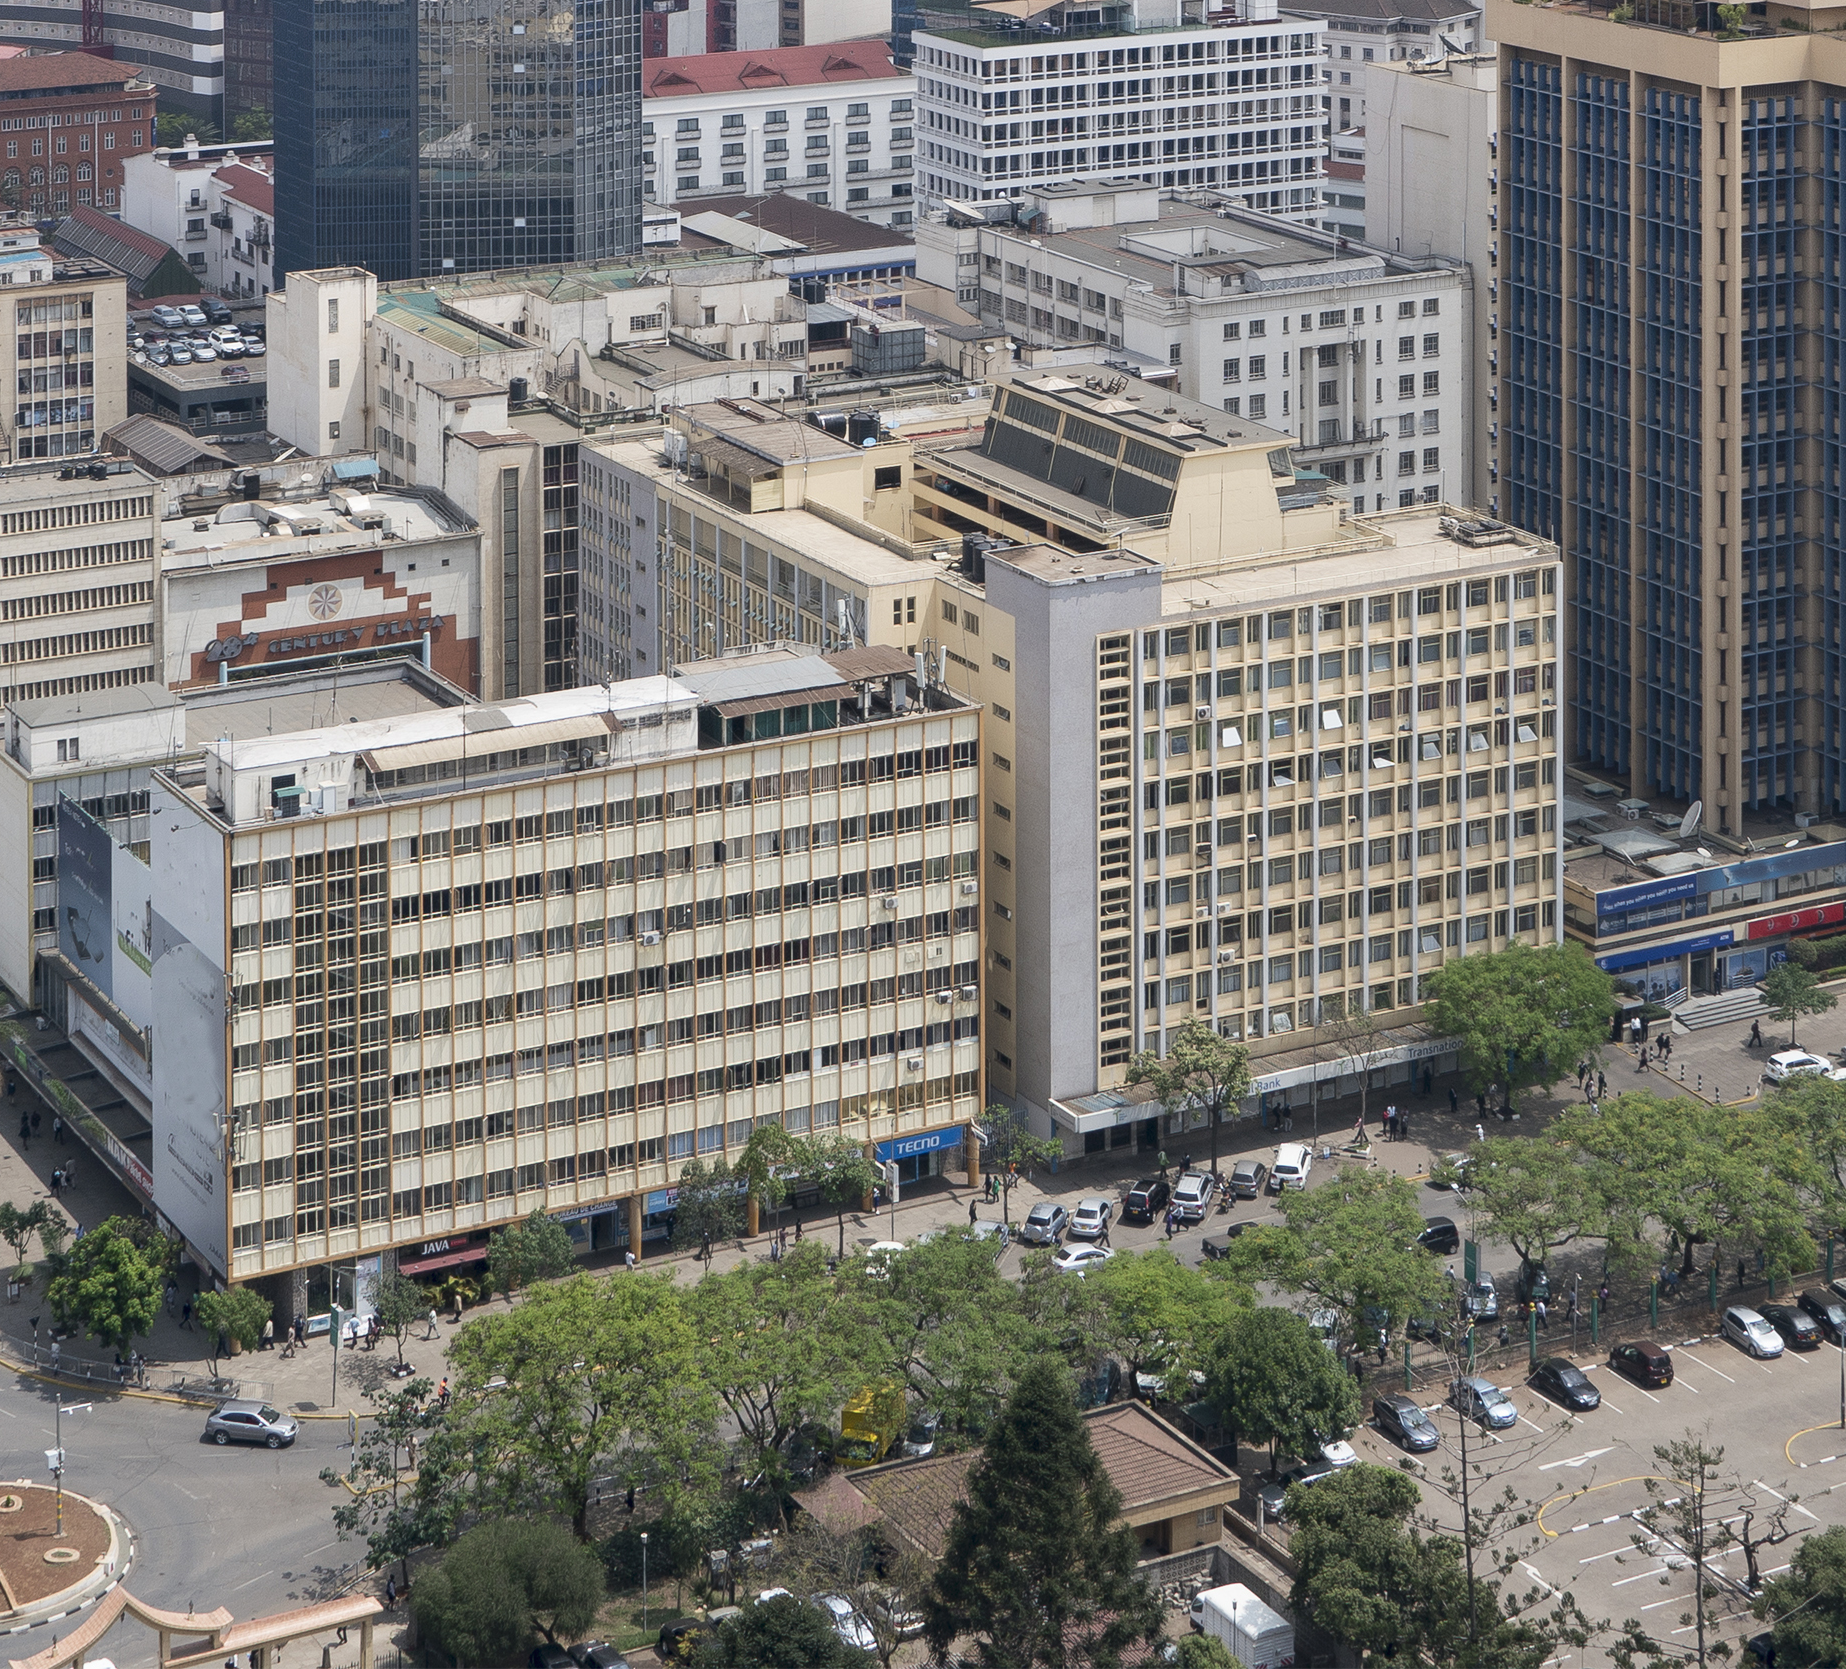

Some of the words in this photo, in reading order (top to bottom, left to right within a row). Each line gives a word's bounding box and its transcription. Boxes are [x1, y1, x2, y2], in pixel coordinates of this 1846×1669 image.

[268, 625, 367, 654] CENTURY
[376, 614, 446, 637] PLAZA
[1408, 1038, 1465, 1058] Transnation
[1257, 1077, 1281, 1091] Bank
[896, 1134, 940, 1154] TECNO
[580, 1205, 590, 1213] DE
[590, 1200, 617, 1211] CHANGE
[421, 1239, 450, 1255] JAVA
